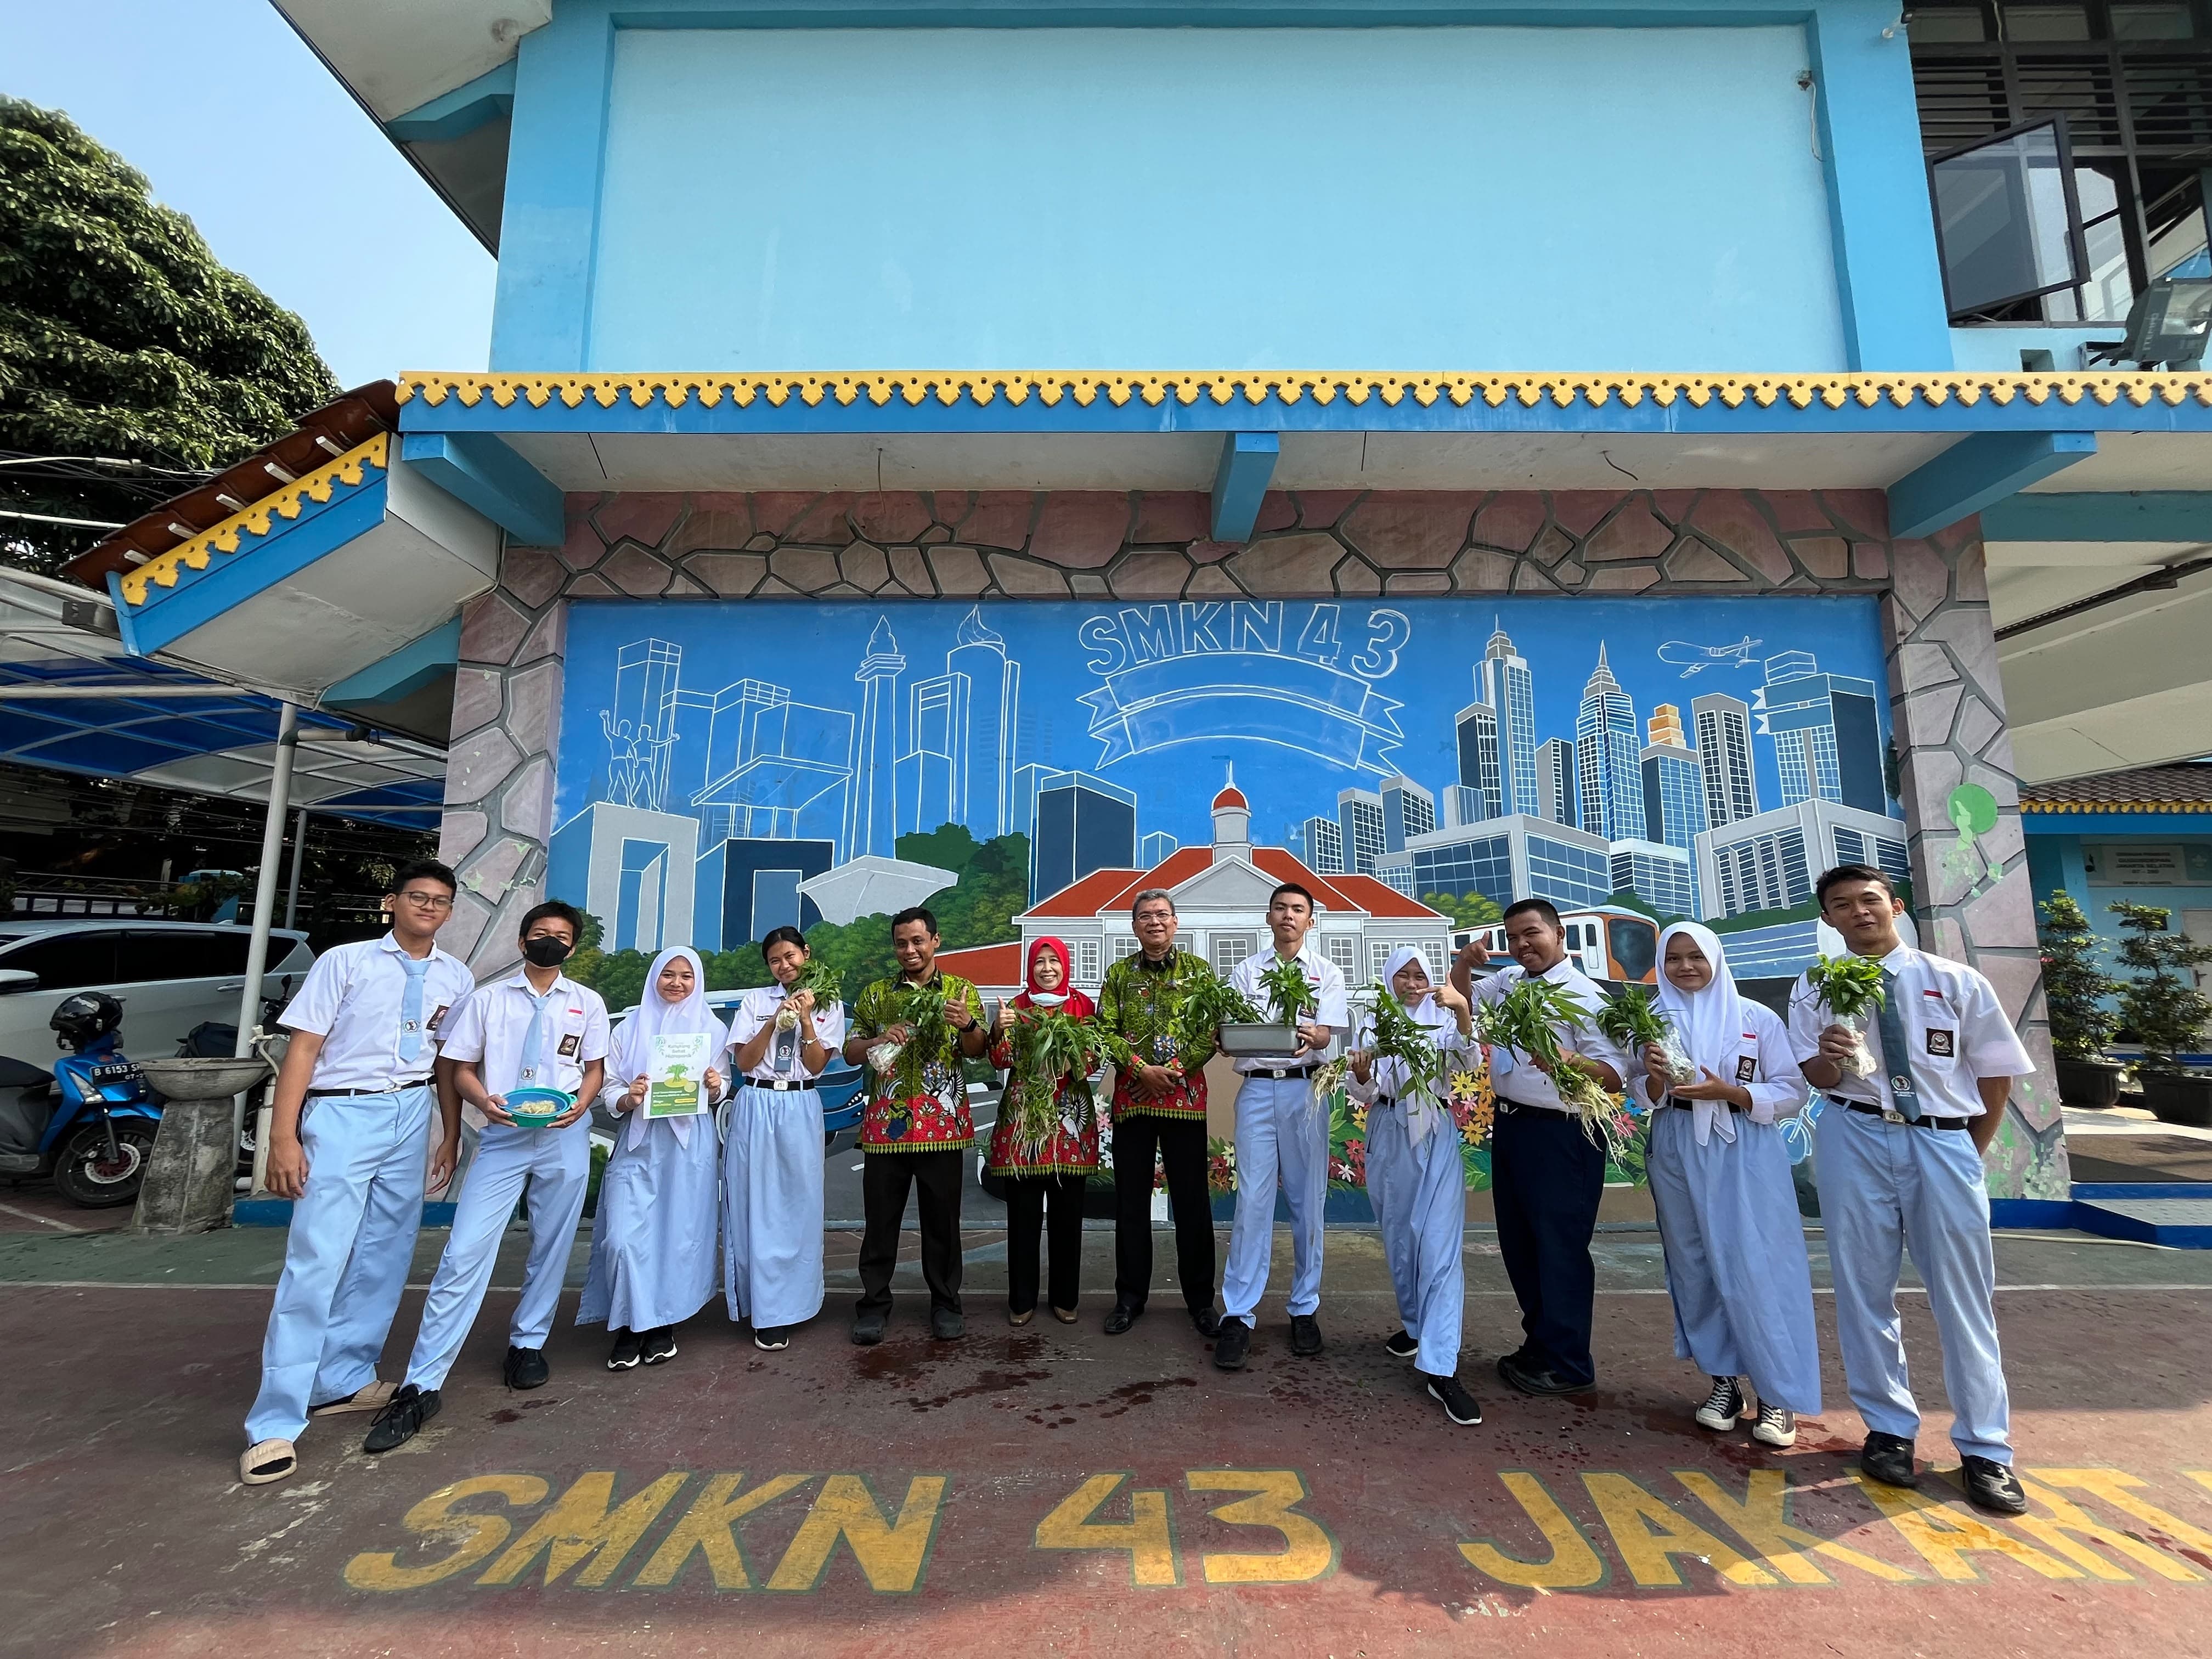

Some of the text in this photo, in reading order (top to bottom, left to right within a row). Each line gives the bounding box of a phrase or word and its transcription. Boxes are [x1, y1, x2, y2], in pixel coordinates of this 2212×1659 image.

[1079, 600, 1411, 679] SMKN 43
[105, 1065, 128, 1074] 6153
[342, 1467, 2212, 1592] SMKN 43 JAKART
